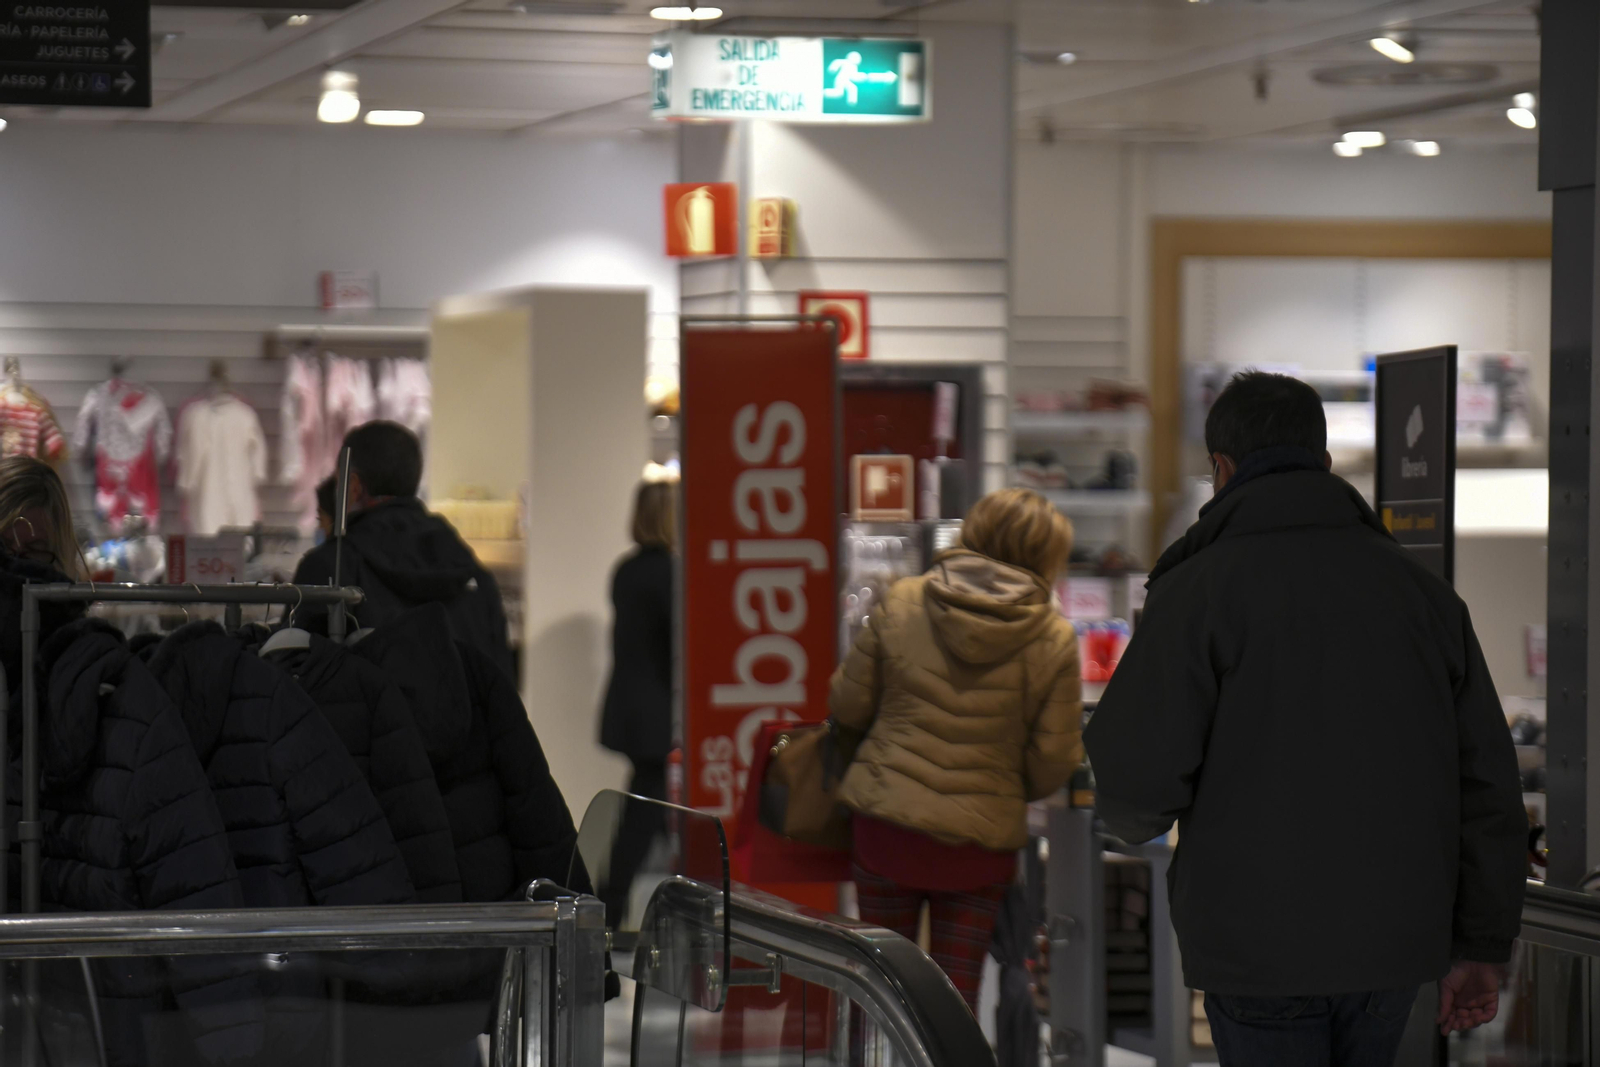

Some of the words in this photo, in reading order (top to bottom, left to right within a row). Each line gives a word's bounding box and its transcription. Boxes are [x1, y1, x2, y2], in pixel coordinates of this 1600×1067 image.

[14, 5, 110, 20] CARROCERÍA
[30, 24, 110, 39] PAPELERÍA
[35, 44, 110, 59] JUGUETES
[719, 38, 780, 61] SALIDA
[0, 73, 48, 88] ASEOS
[738, 64, 761, 86] DE
[691, 87, 808, 112] EMERGENCIA
